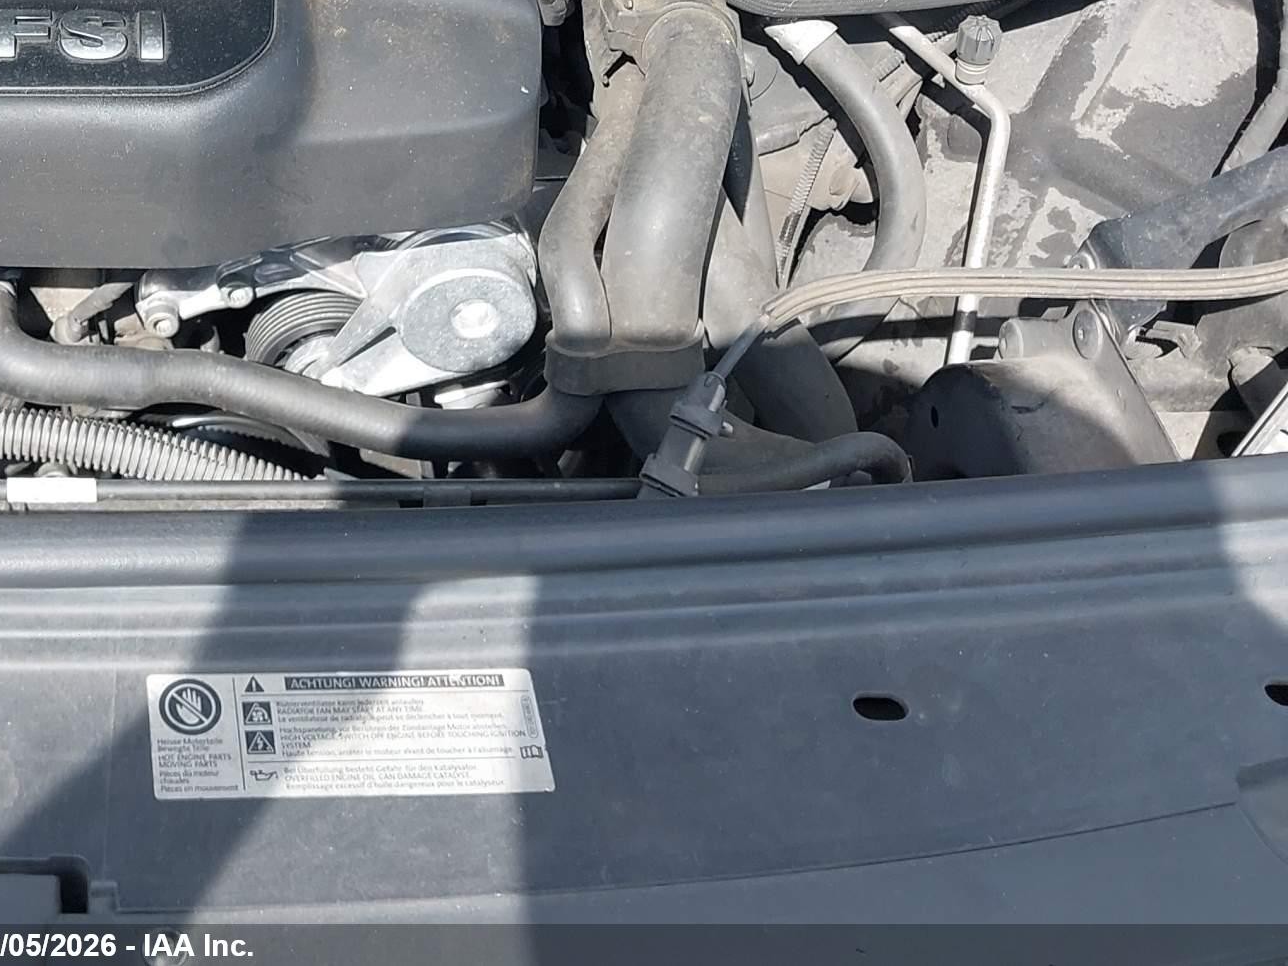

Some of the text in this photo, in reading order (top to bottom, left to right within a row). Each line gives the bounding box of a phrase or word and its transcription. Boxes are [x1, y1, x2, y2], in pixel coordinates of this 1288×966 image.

[290, 678, 356, 688] ACHTUNG!
[359, 677, 425, 687] WARNING!
[333, 706, 350, 714] MAY
[352, 706, 373, 714] START
[491, 730, 526, 738] IGNITION
